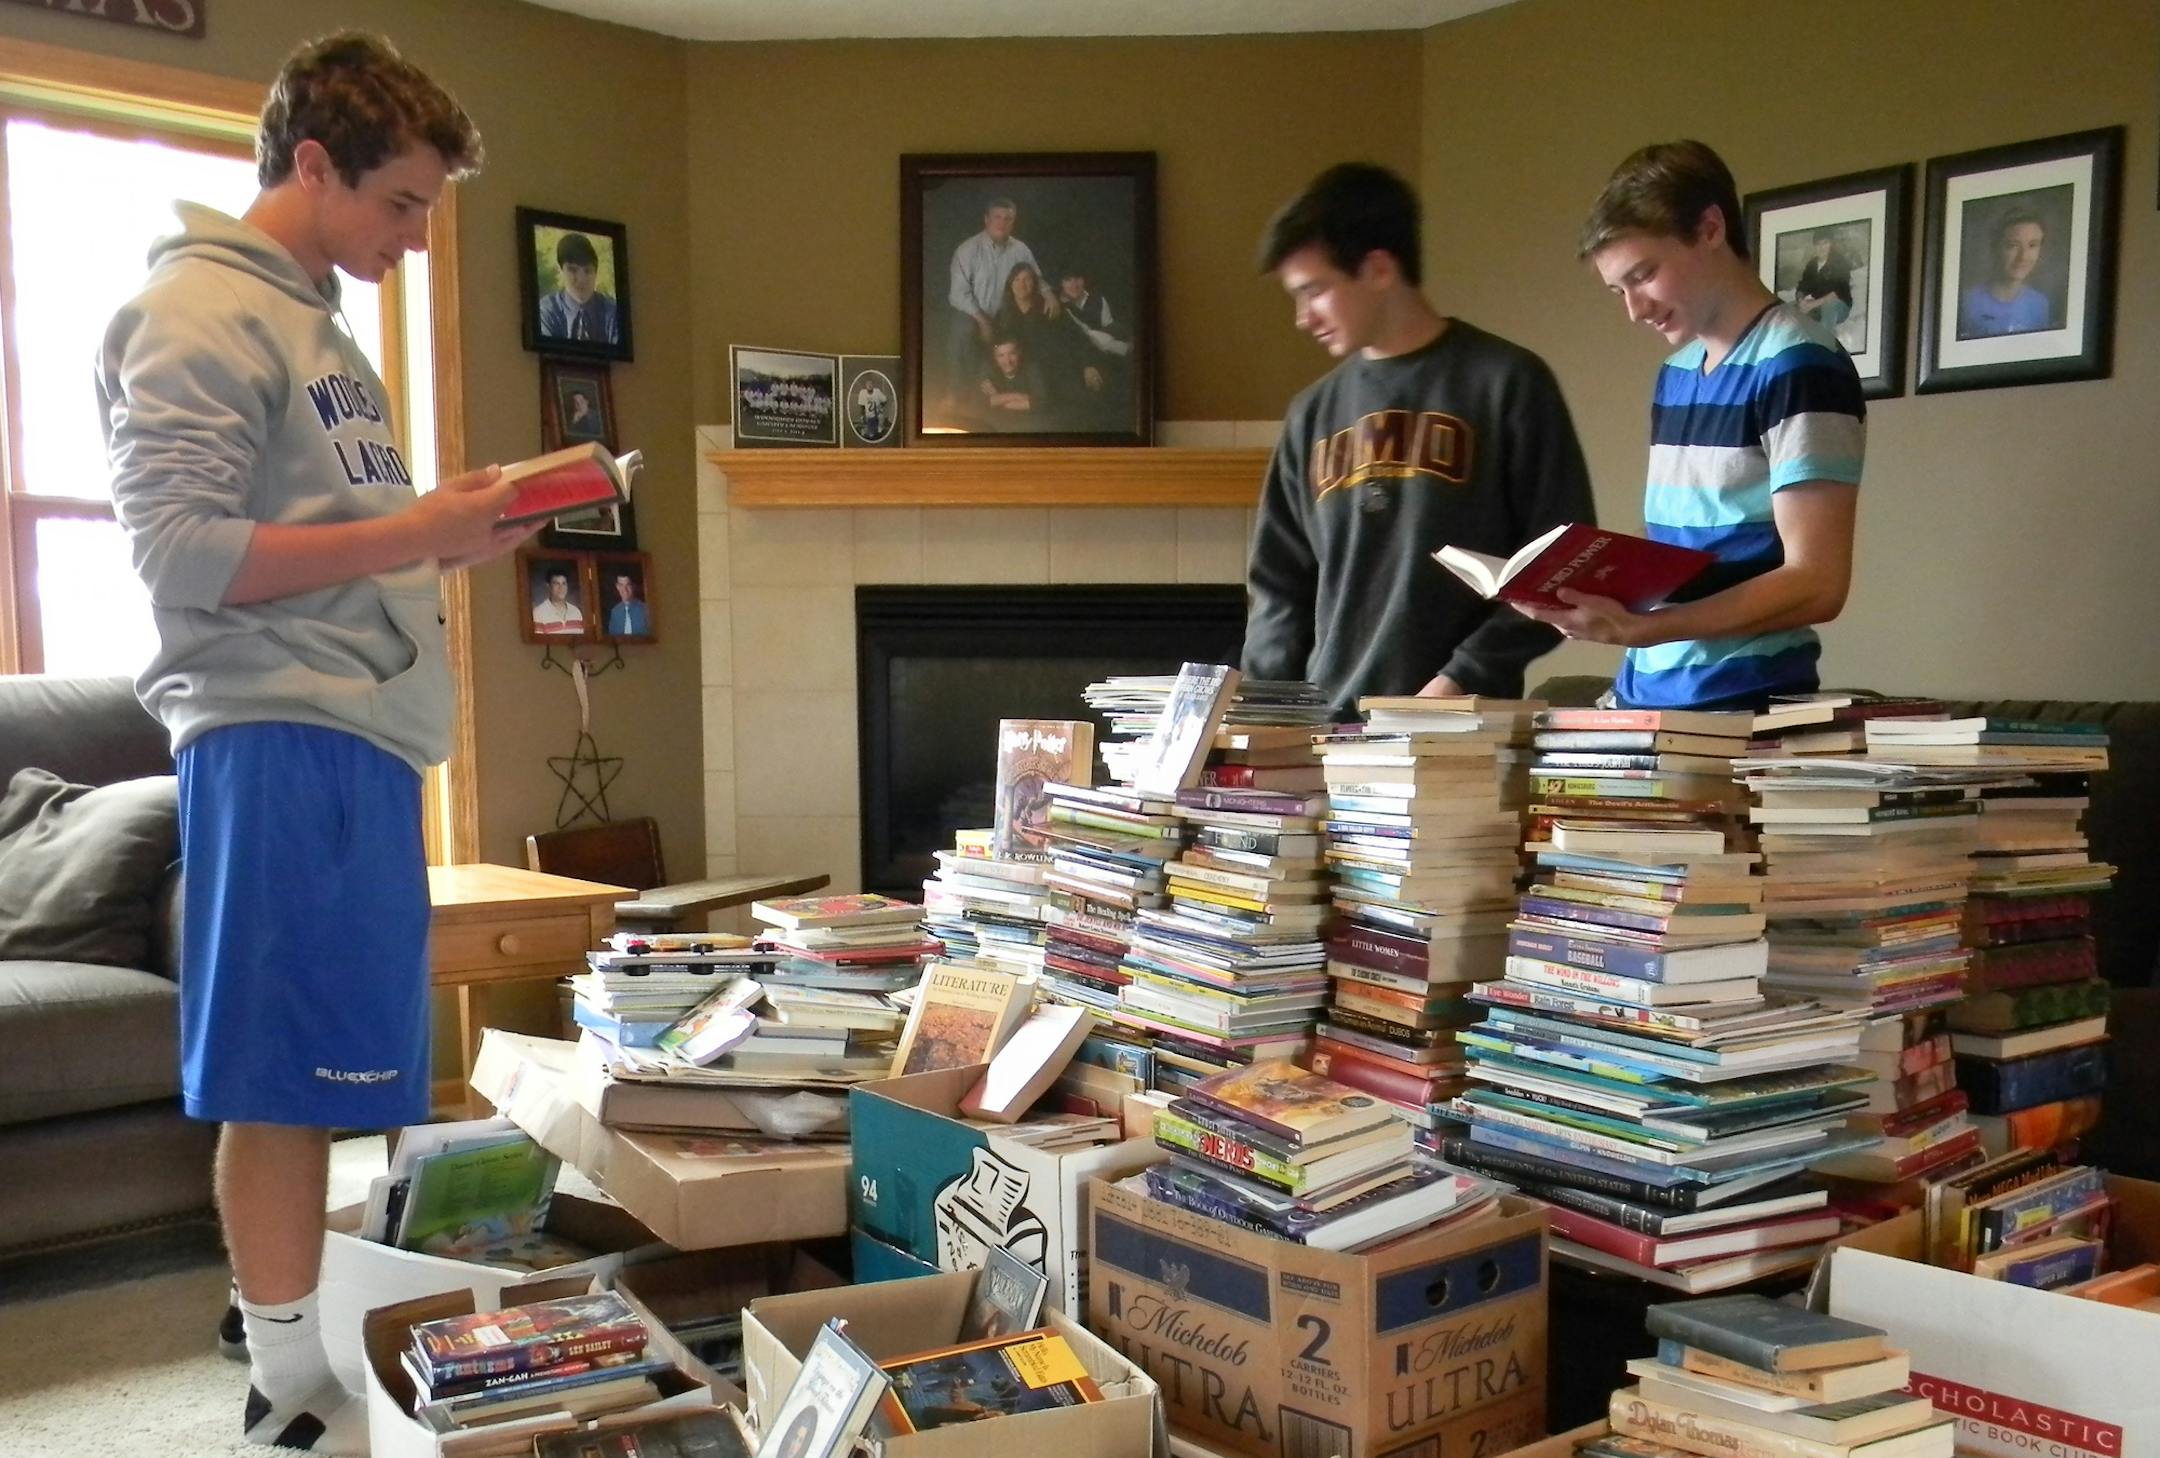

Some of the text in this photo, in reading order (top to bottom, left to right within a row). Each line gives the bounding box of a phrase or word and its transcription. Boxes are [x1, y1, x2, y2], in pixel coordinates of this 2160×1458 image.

[1351, 940, 1400, 958] LITTLE WOMEN
[932, 974, 1010, 997] LITERATURE
[1551, 997, 1575, 1011] Forest
[1202, 1133, 1256, 1170] NERDS
[861, 1175, 878, 1201] 94
[1127, 1294, 1249, 1367] Michelob
[1297, 1314, 1331, 1366] 2
[1413, 1312, 1518, 1372] Michelob
[484, 1372, 528, 1388] ZAN-GAH
[1101, 1328, 1273, 1441] TRA
[1290, 1359, 1341, 1381] CARRIERS
[1291, 1383, 1341, 1406] BOTTLES
[1385, 1350, 1528, 1432] ULTRA
[1627, 1401, 1677, 1436] Dylan
[1676, 1412, 1741, 1451] Thomas
[1900, 1378, 2116, 1449] SCHOLASTIC
[1987, 1427, 2042, 1453] BOOK
